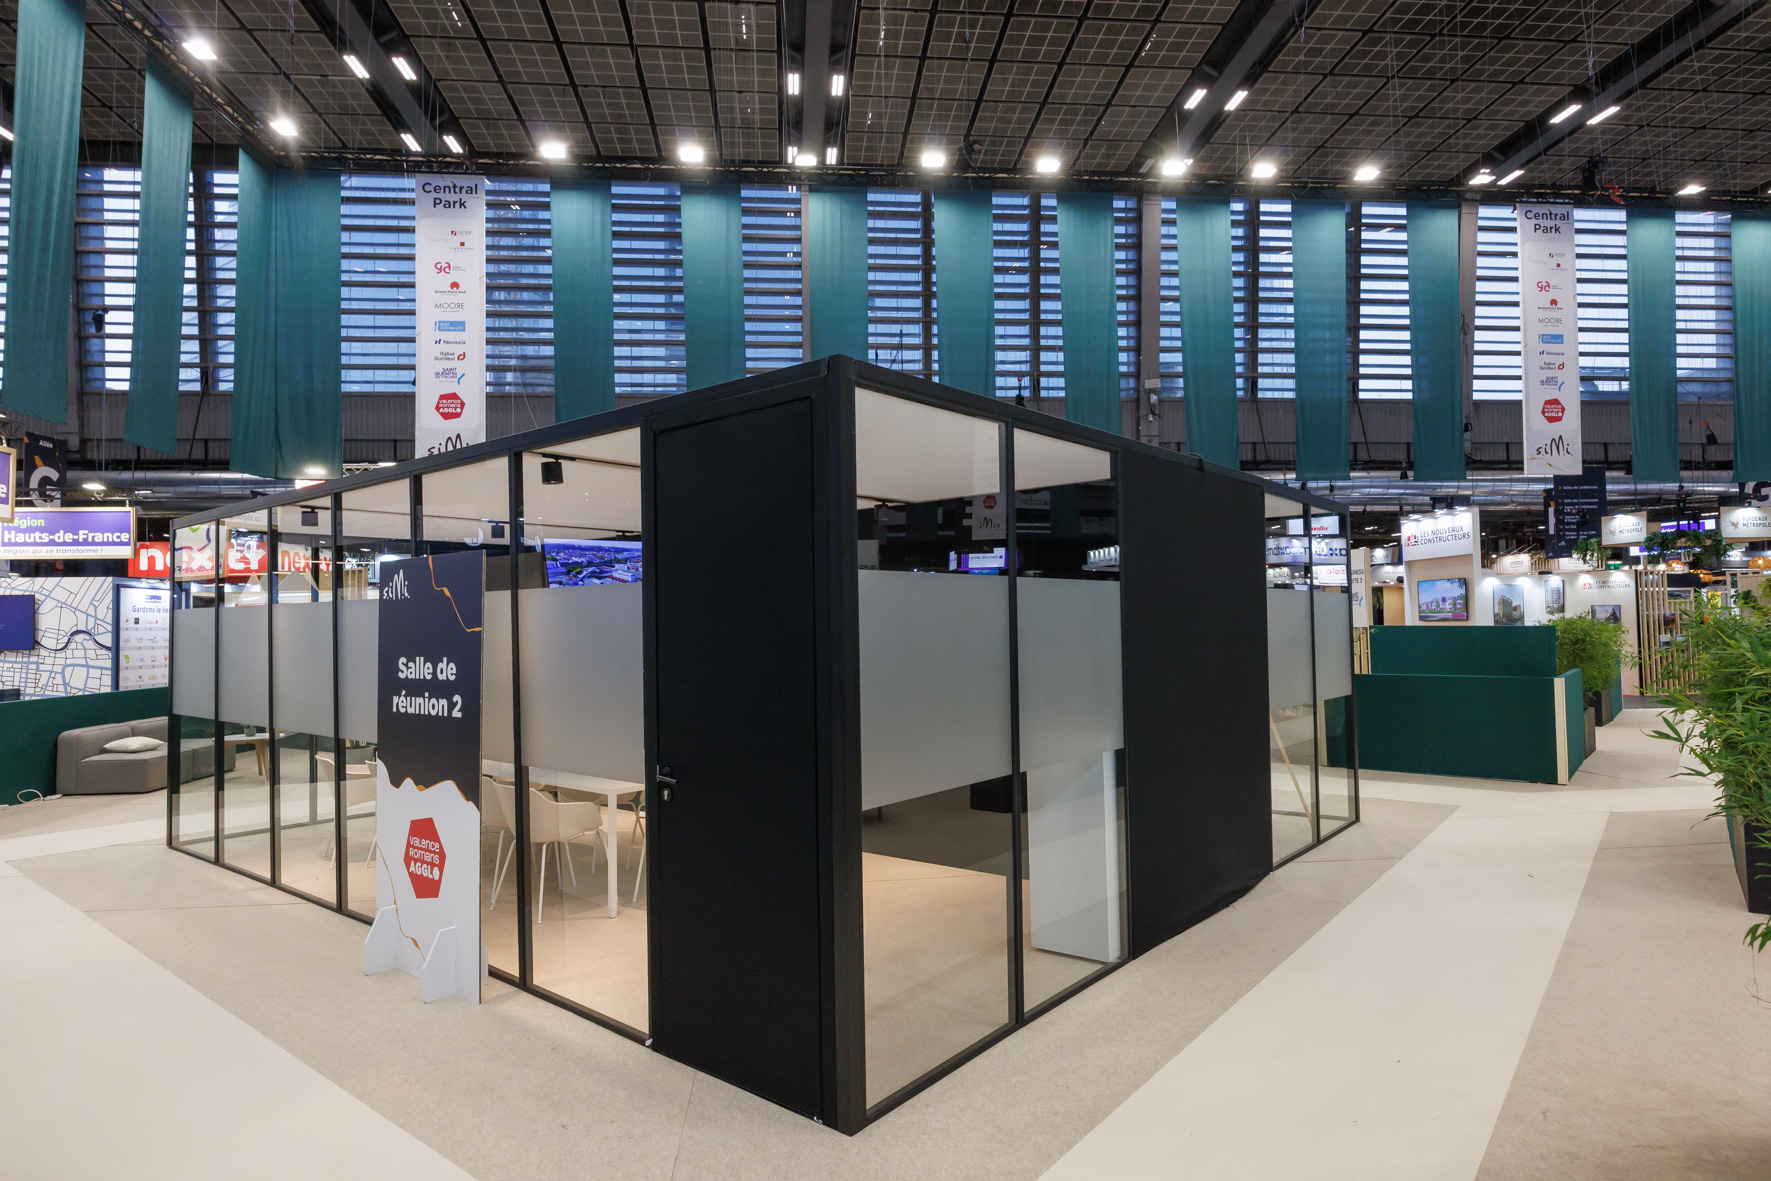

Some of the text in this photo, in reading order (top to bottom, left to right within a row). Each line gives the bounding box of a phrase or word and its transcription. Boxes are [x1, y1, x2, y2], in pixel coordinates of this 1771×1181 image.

[422, 182, 478, 194] Central
[434, 197, 467, 209] Park
[1524, 210, 1569, 221] Central
[1534, 223, 1561, 234] Park
[39, 439, 54, 448] Allée
[29, 466, 61, 507] G
[4, 530, 129, 543] Hauts-de-France
[1431, 526, 1464, 536] NOUVEAUX
[1420, 532, 1470, 545] CONSTRUCTEURS
[140, 548, 266, 570] nexty
[398, 656, 456, 680] Salle de
[392, 690, 462, 718] réunion 2
[409, 860, 440, 880] AGGLO
